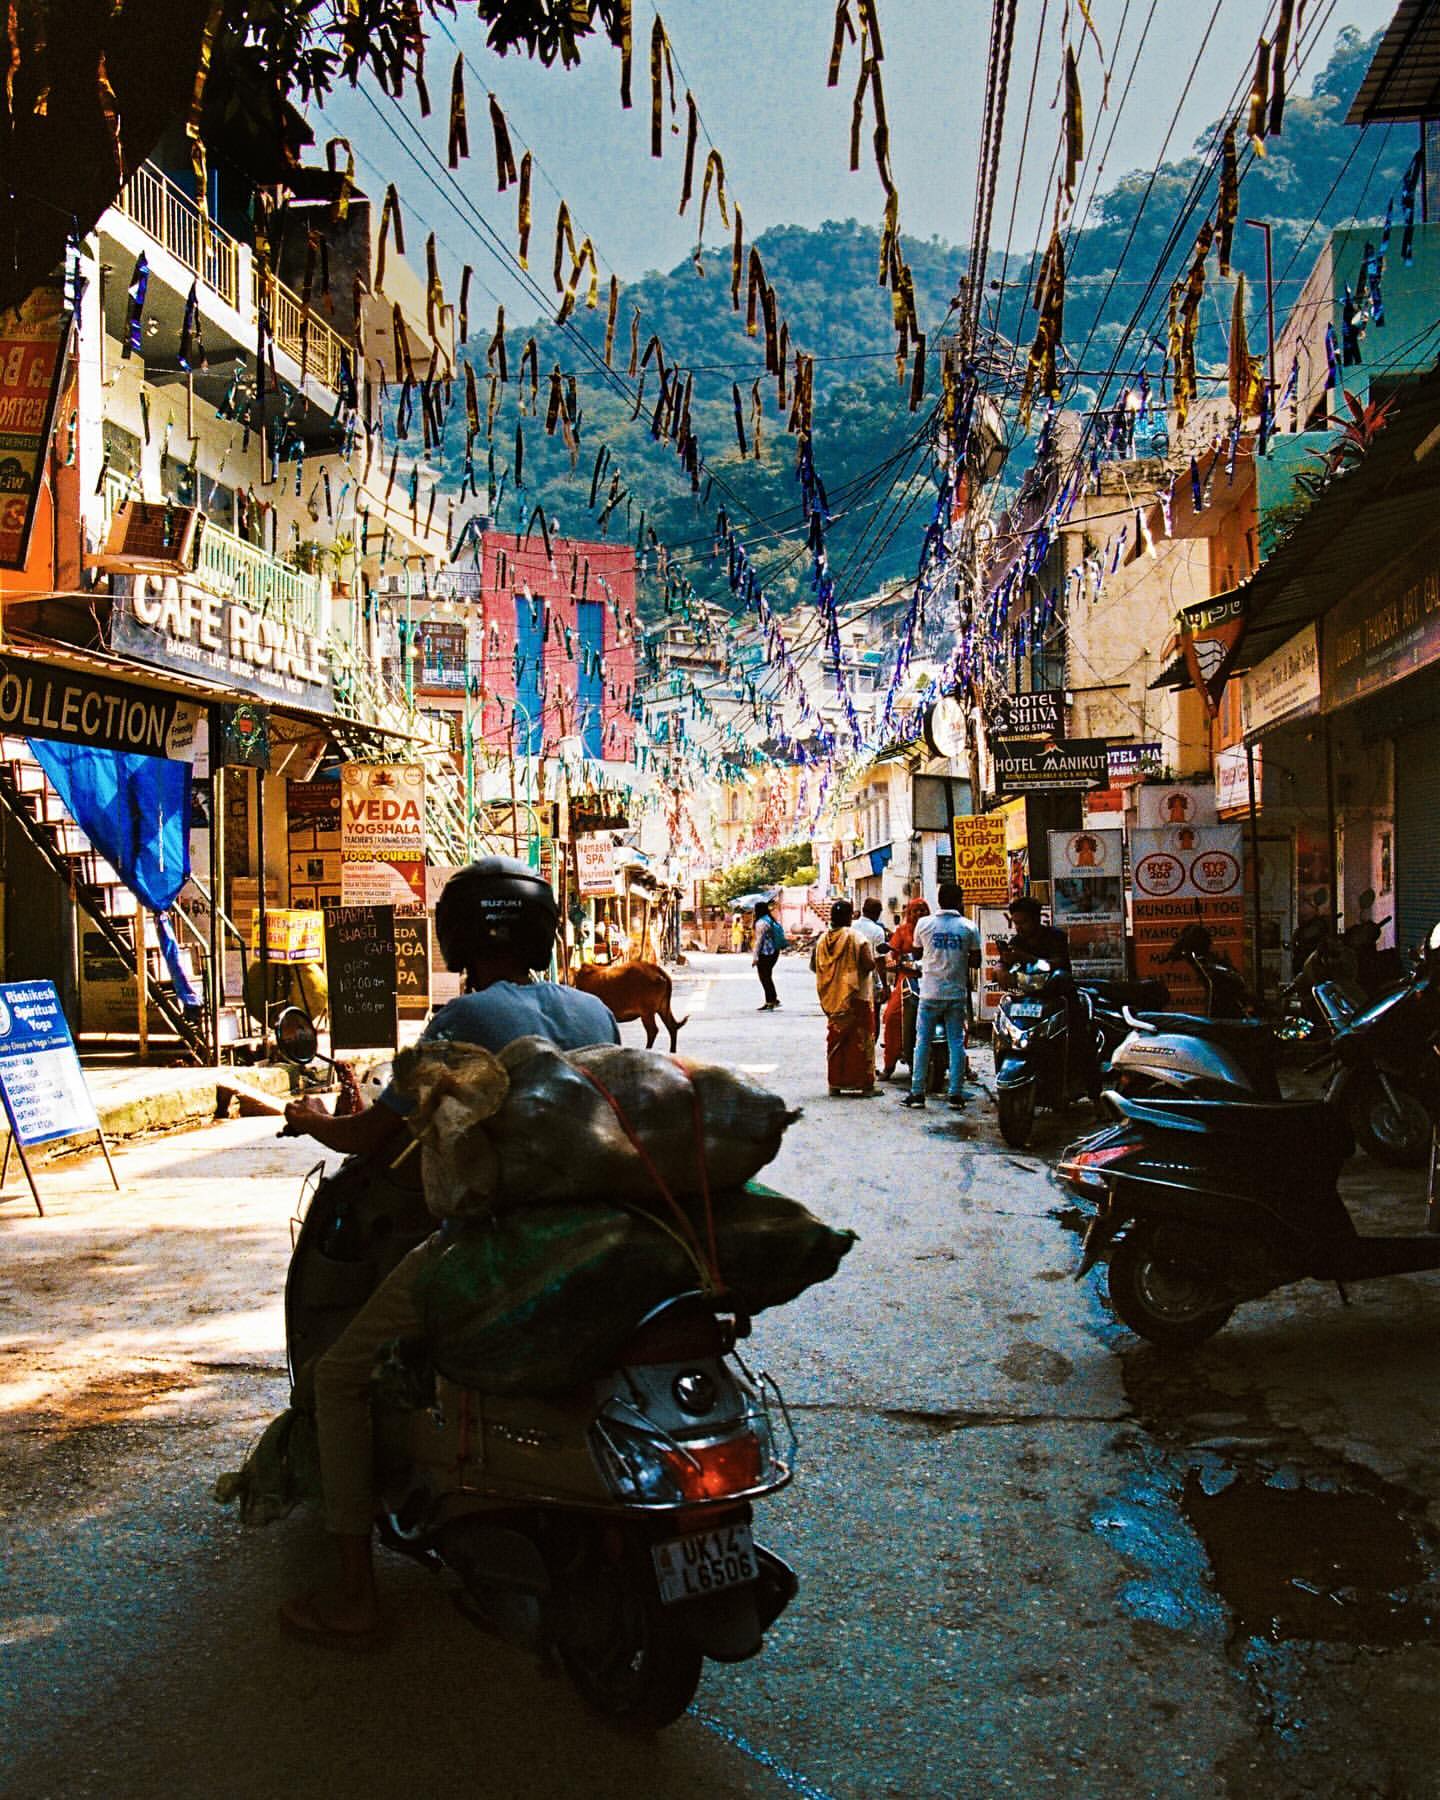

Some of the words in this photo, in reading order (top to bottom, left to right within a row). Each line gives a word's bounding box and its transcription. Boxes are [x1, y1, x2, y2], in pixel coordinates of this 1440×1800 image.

[134, 574, 223, 649] CAFE
[229, 604, 329, 685] ROYALE
[166, 637, 201, 662] BAKERY
[1011, 694, 1056, 708] HOTEL
[1009, 707, 1058, 724] SHIVA
[1015, 724, 1030, 732] YOG
[1032, 723, 1055, 731] STHAL
[995, 758, 1037, 773] HOTEL
[1043, 756, 1106, 770] MANIKUT
[347, 800, 420, 820] VEDA
[347, 823, 420, 834] YOGSHALA
[344, 835, 373, 844] TEACHER'S
[344, 850, 373, 863] YOGA
[375, 850, 421, 863] COURSES
[586, 854, 605, 865] SPA
[958, 870, 973, 878] TWO
[958, 876, 1008, 888] PARKING
[328, 907, 376, 928] DHARMA
[399, 959, 406, 967] &
[5, 987, 56, 1004] Rishikesh
[14, 1002, 58, 1021] Spiritual
[28, 1019, 53, 1032] Yoga
[683, 1553, 752, 1593] L6506
